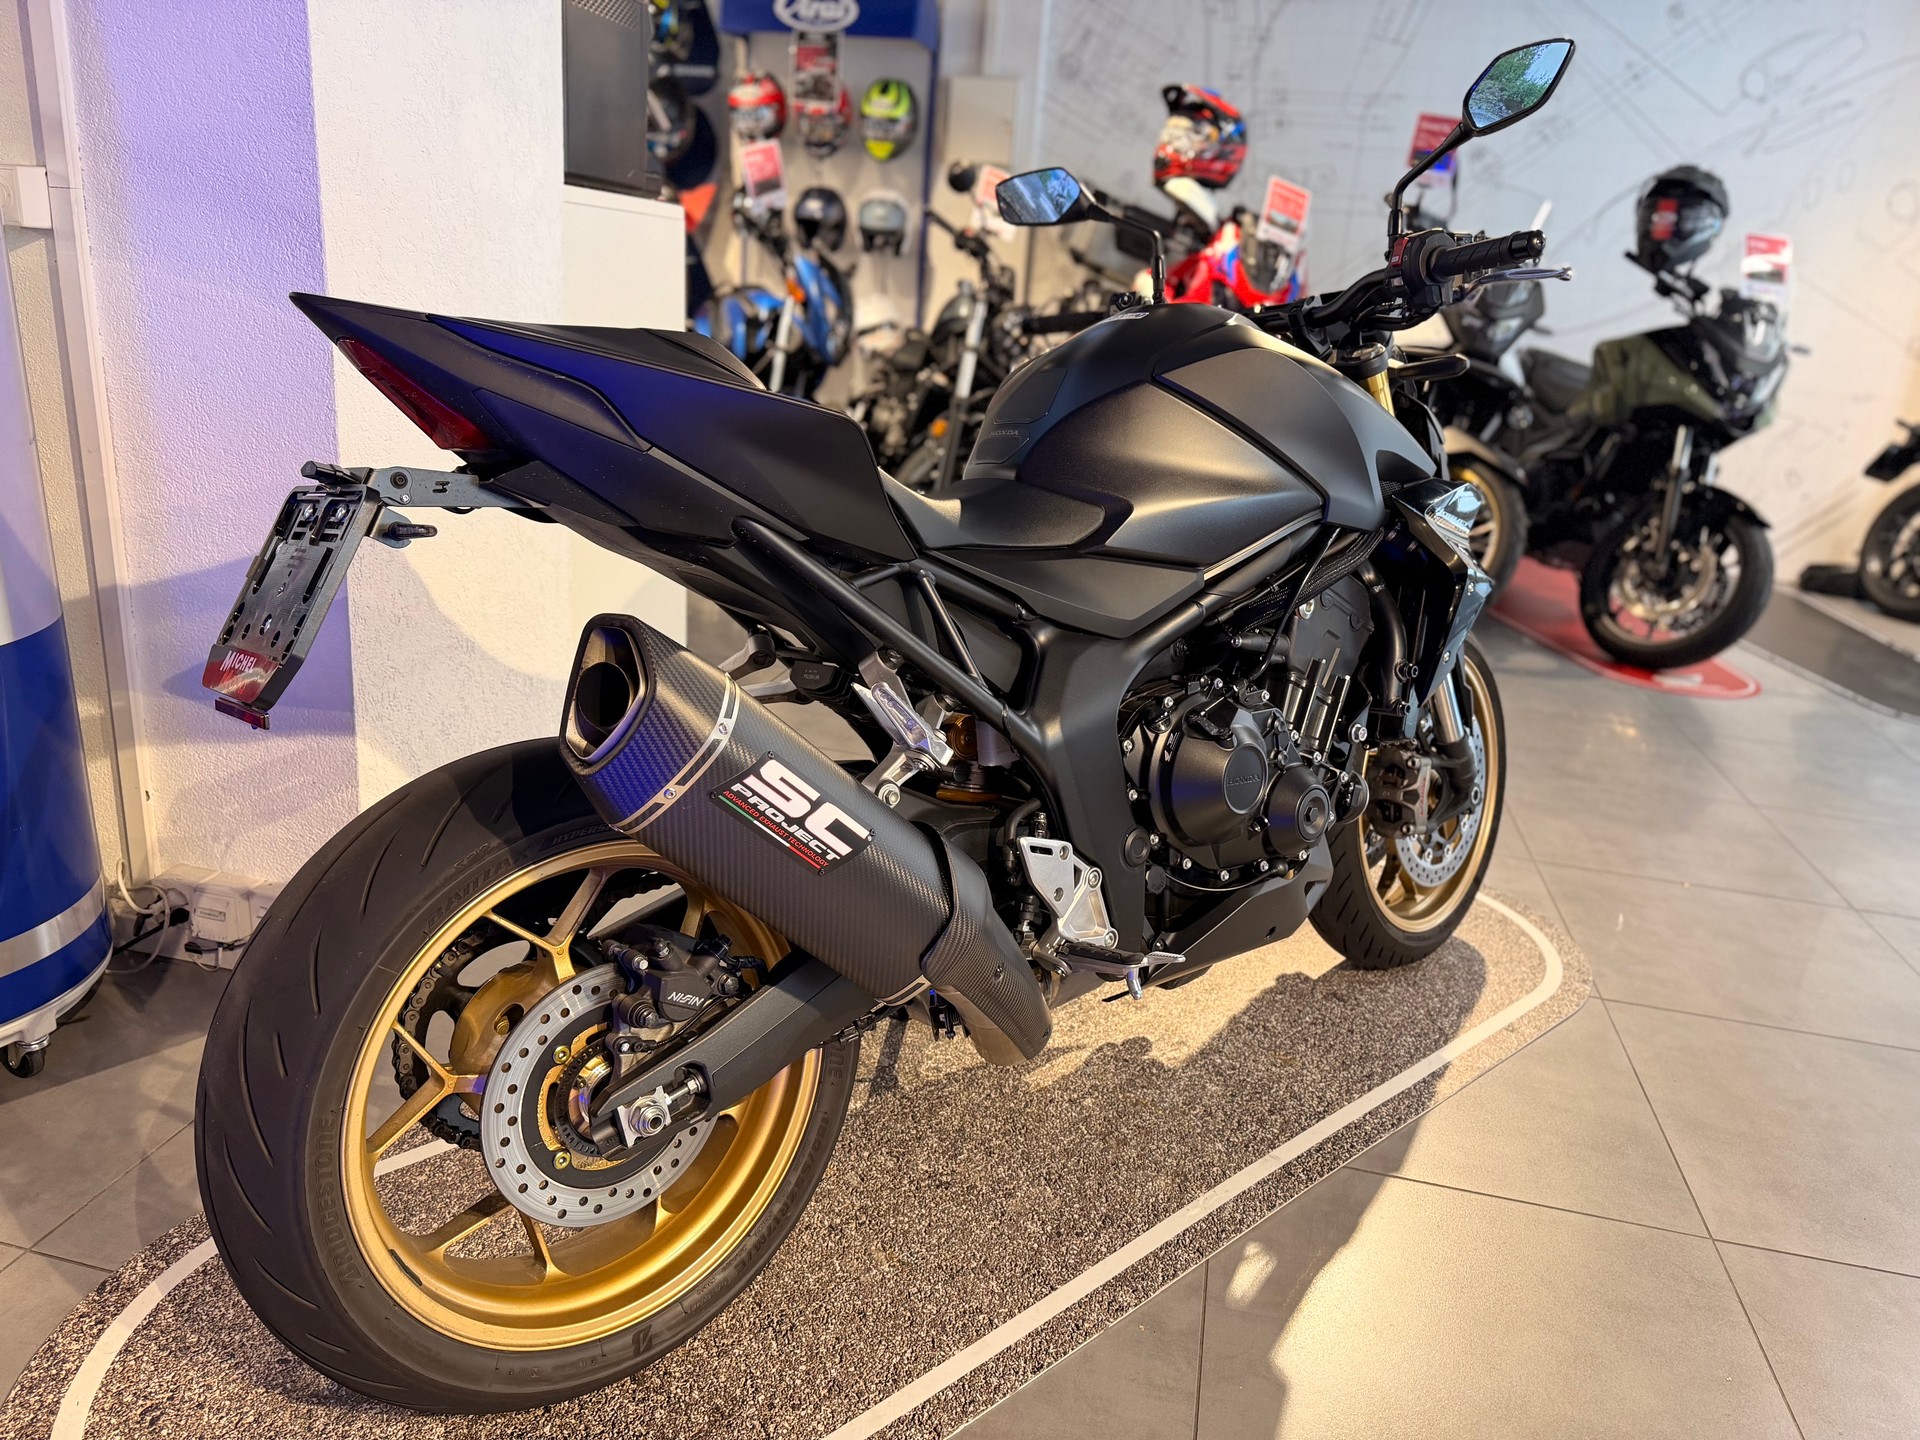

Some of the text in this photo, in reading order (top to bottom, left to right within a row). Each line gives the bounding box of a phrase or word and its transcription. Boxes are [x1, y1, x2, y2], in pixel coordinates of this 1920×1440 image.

[220, 650, 257, 673] MICHEL
[742, 759, 870, 857] SC
[1226, 774, 1261, 786] HONDA
[723, 790, 829, 867] ADVANCED EXHAUST TECHNOLOGY
[730, 782, 841, 862] PROJECT
[667, 991, 705, 1007] NISSIN
[314, 1115, 362, 1288] BRIDGESTONE
